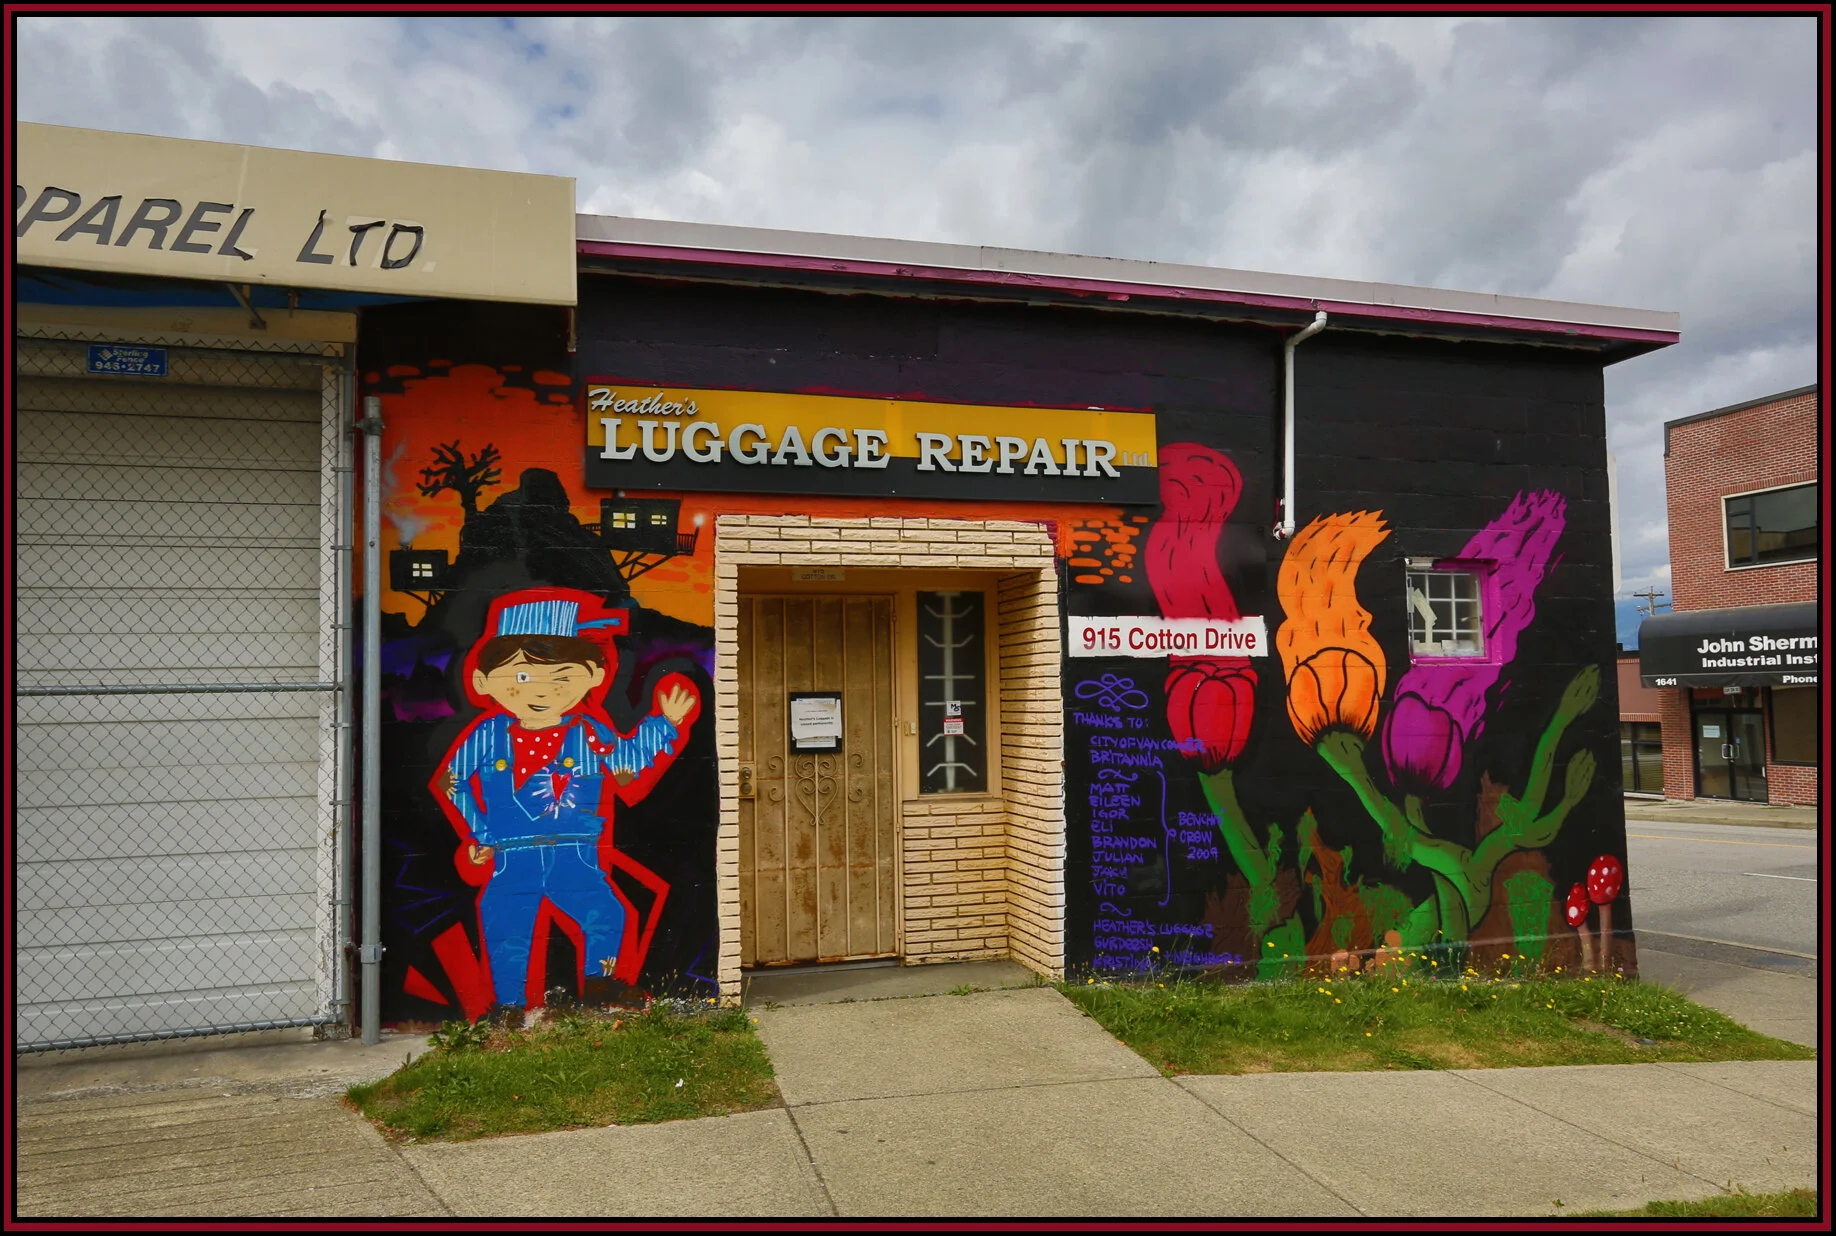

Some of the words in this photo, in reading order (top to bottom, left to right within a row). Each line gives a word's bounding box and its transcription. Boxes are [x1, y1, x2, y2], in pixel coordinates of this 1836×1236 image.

[588, 388, 700, 416] Heather's
[600, 417, 889, 469] LUGGAGE
[916, 432, 1120, 478] REPAIR
[1082, 627, 1121, 650] 915
[1128, 627, 1198, 650] Cotton
[1205, 627, 1256, 649] Drive
[1697, 638, 1745, 653] John
[1702, 655, 1781, 668] Industrial
[1655, 677, 1677, 686] 1641
[1073, 712, 1123, 729] THANKS
[1089, 749, 1164, 768] BRITANNIA
[1090, 783, 1130, 796] MATT
[1088, 794, 1141, 808] EILEEN
[1092, 808, 1130, 820] IGOR
[1091, 820, 1113, 833] ELI
[1091, 835, 1158, 850] BRANDON
[1092, 850, 1145, 865] JULIAN
[1093, 879, 1126, 896] VITO
[1093, 918, 1156, 937] HEATHER'S
